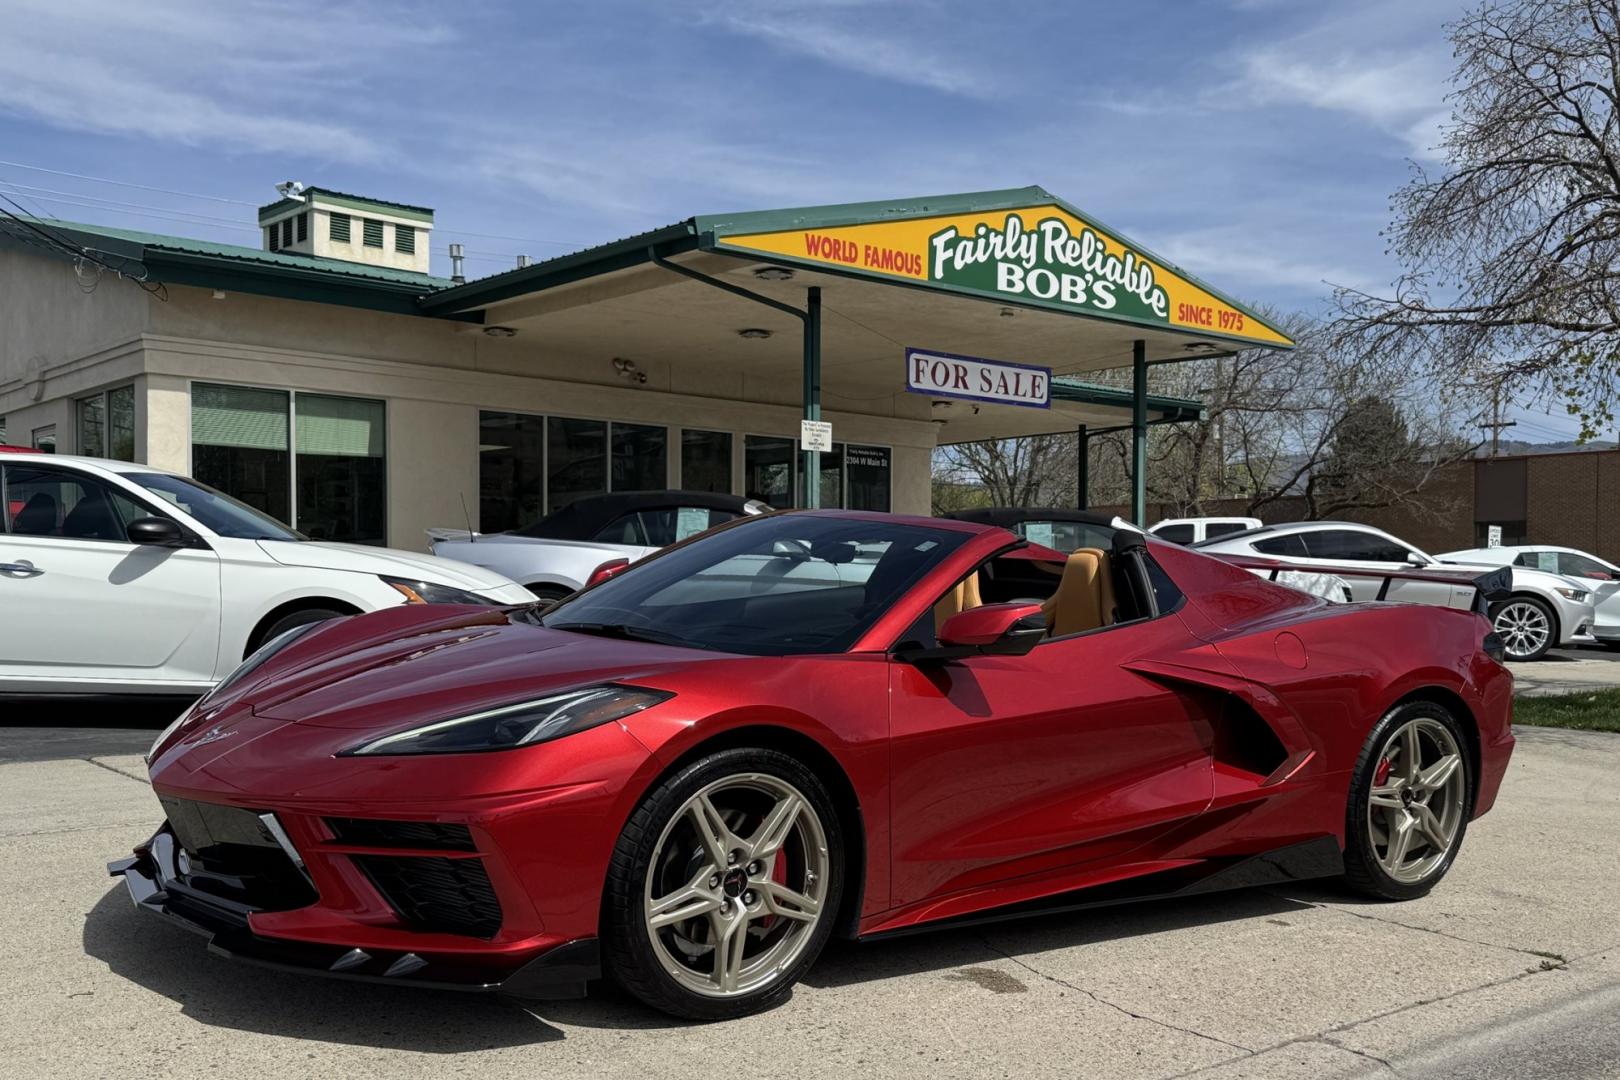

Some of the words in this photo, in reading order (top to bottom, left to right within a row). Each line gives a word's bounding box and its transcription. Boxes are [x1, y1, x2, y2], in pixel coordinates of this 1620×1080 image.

[805, 233, 858, 263] WORLD
[864, 245, 921, 275] FAMOUS
[933, 217, 1038, 279] Fairly
[1040, 220, 1167, 317] Reliable
[997, 261, 1116, 309] BOB'S
[1178, 303, 1212, 326] SINCE
[1218, 310, 1243, 331] 1975
[913, 358, 969, 390] FOR
[980, 367, 1043, 399] SALE
[860, 457, 866, 465] W
[867, 457, 880, 466] Main
